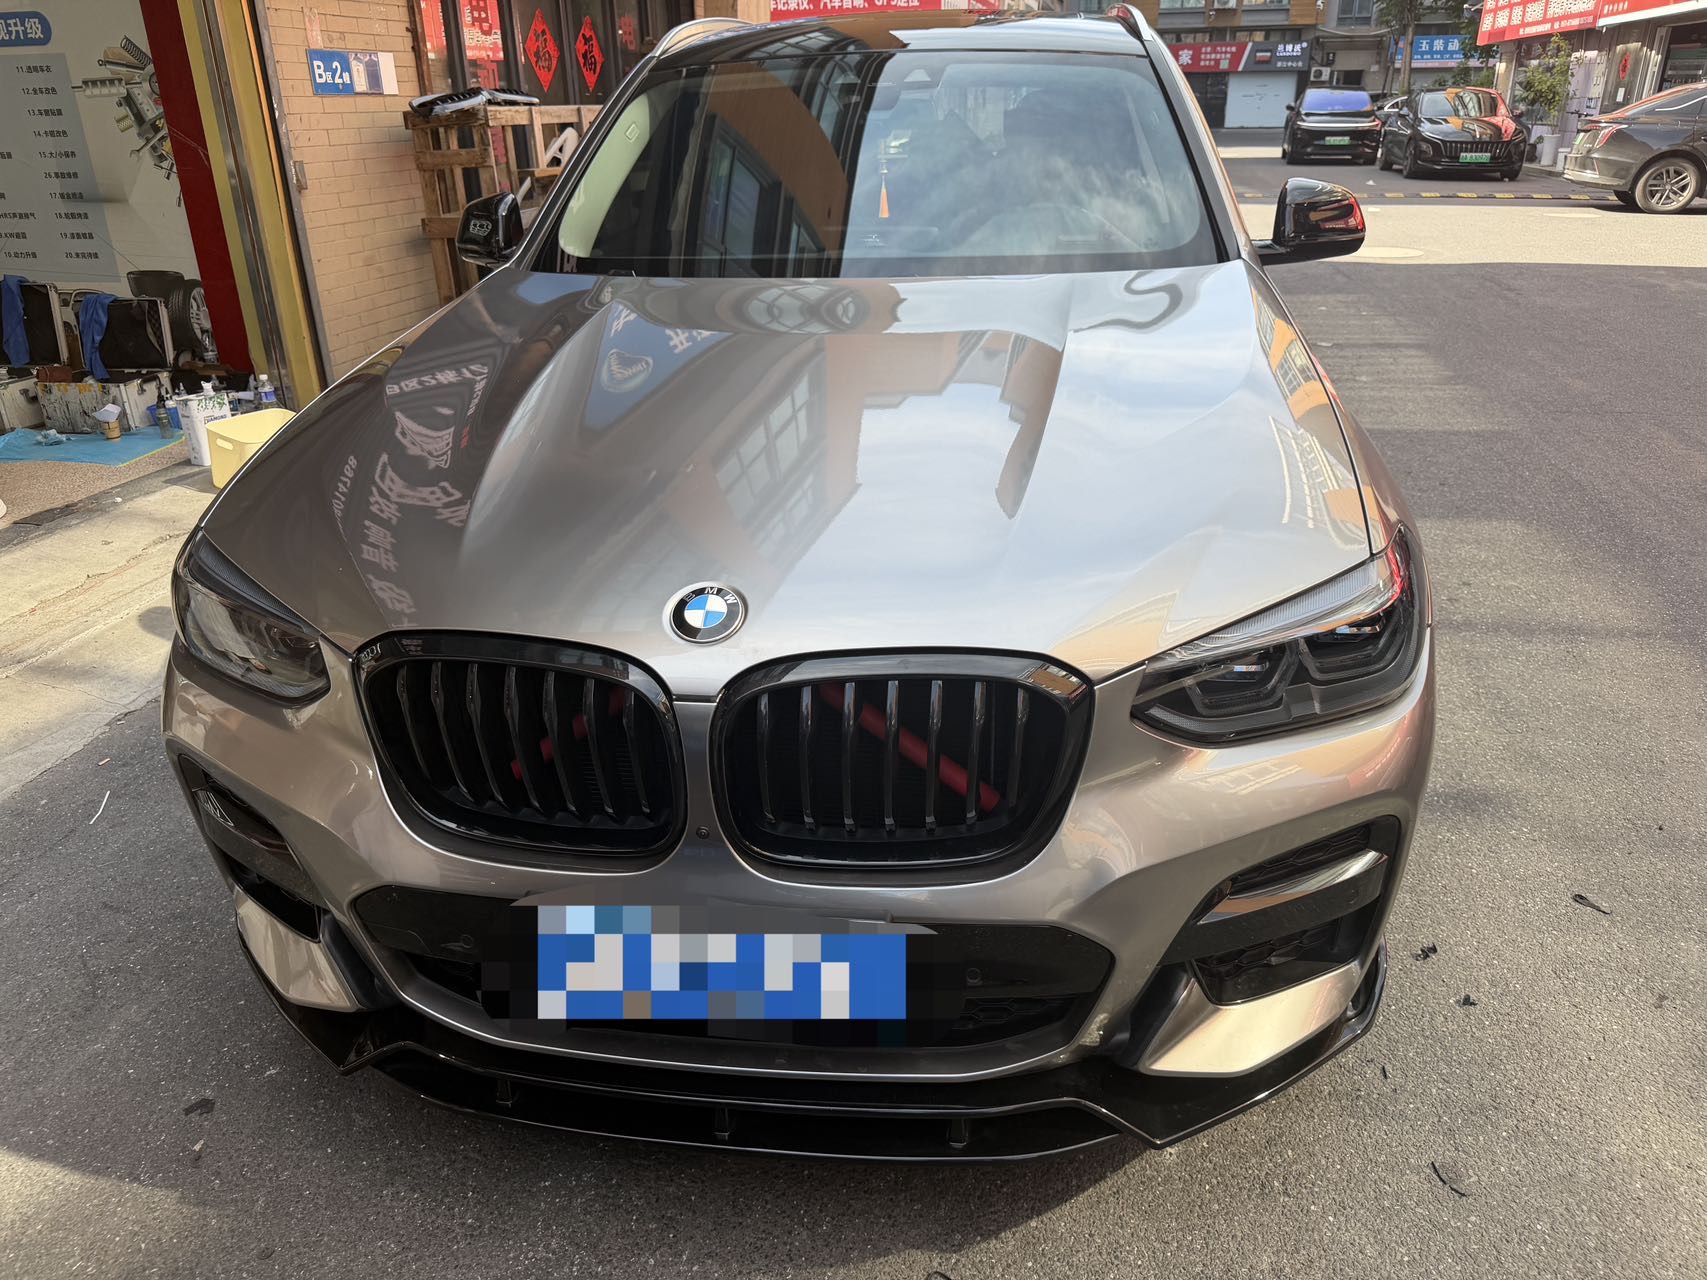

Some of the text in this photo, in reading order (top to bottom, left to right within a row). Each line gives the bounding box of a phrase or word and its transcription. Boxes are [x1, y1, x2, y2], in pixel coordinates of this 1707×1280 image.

[532, 28, 553, 73] 福
[581, 32, 598, 76] 福
[1178, 49, 1193, 65] 家
[683, 586, 738, 605] BMW
